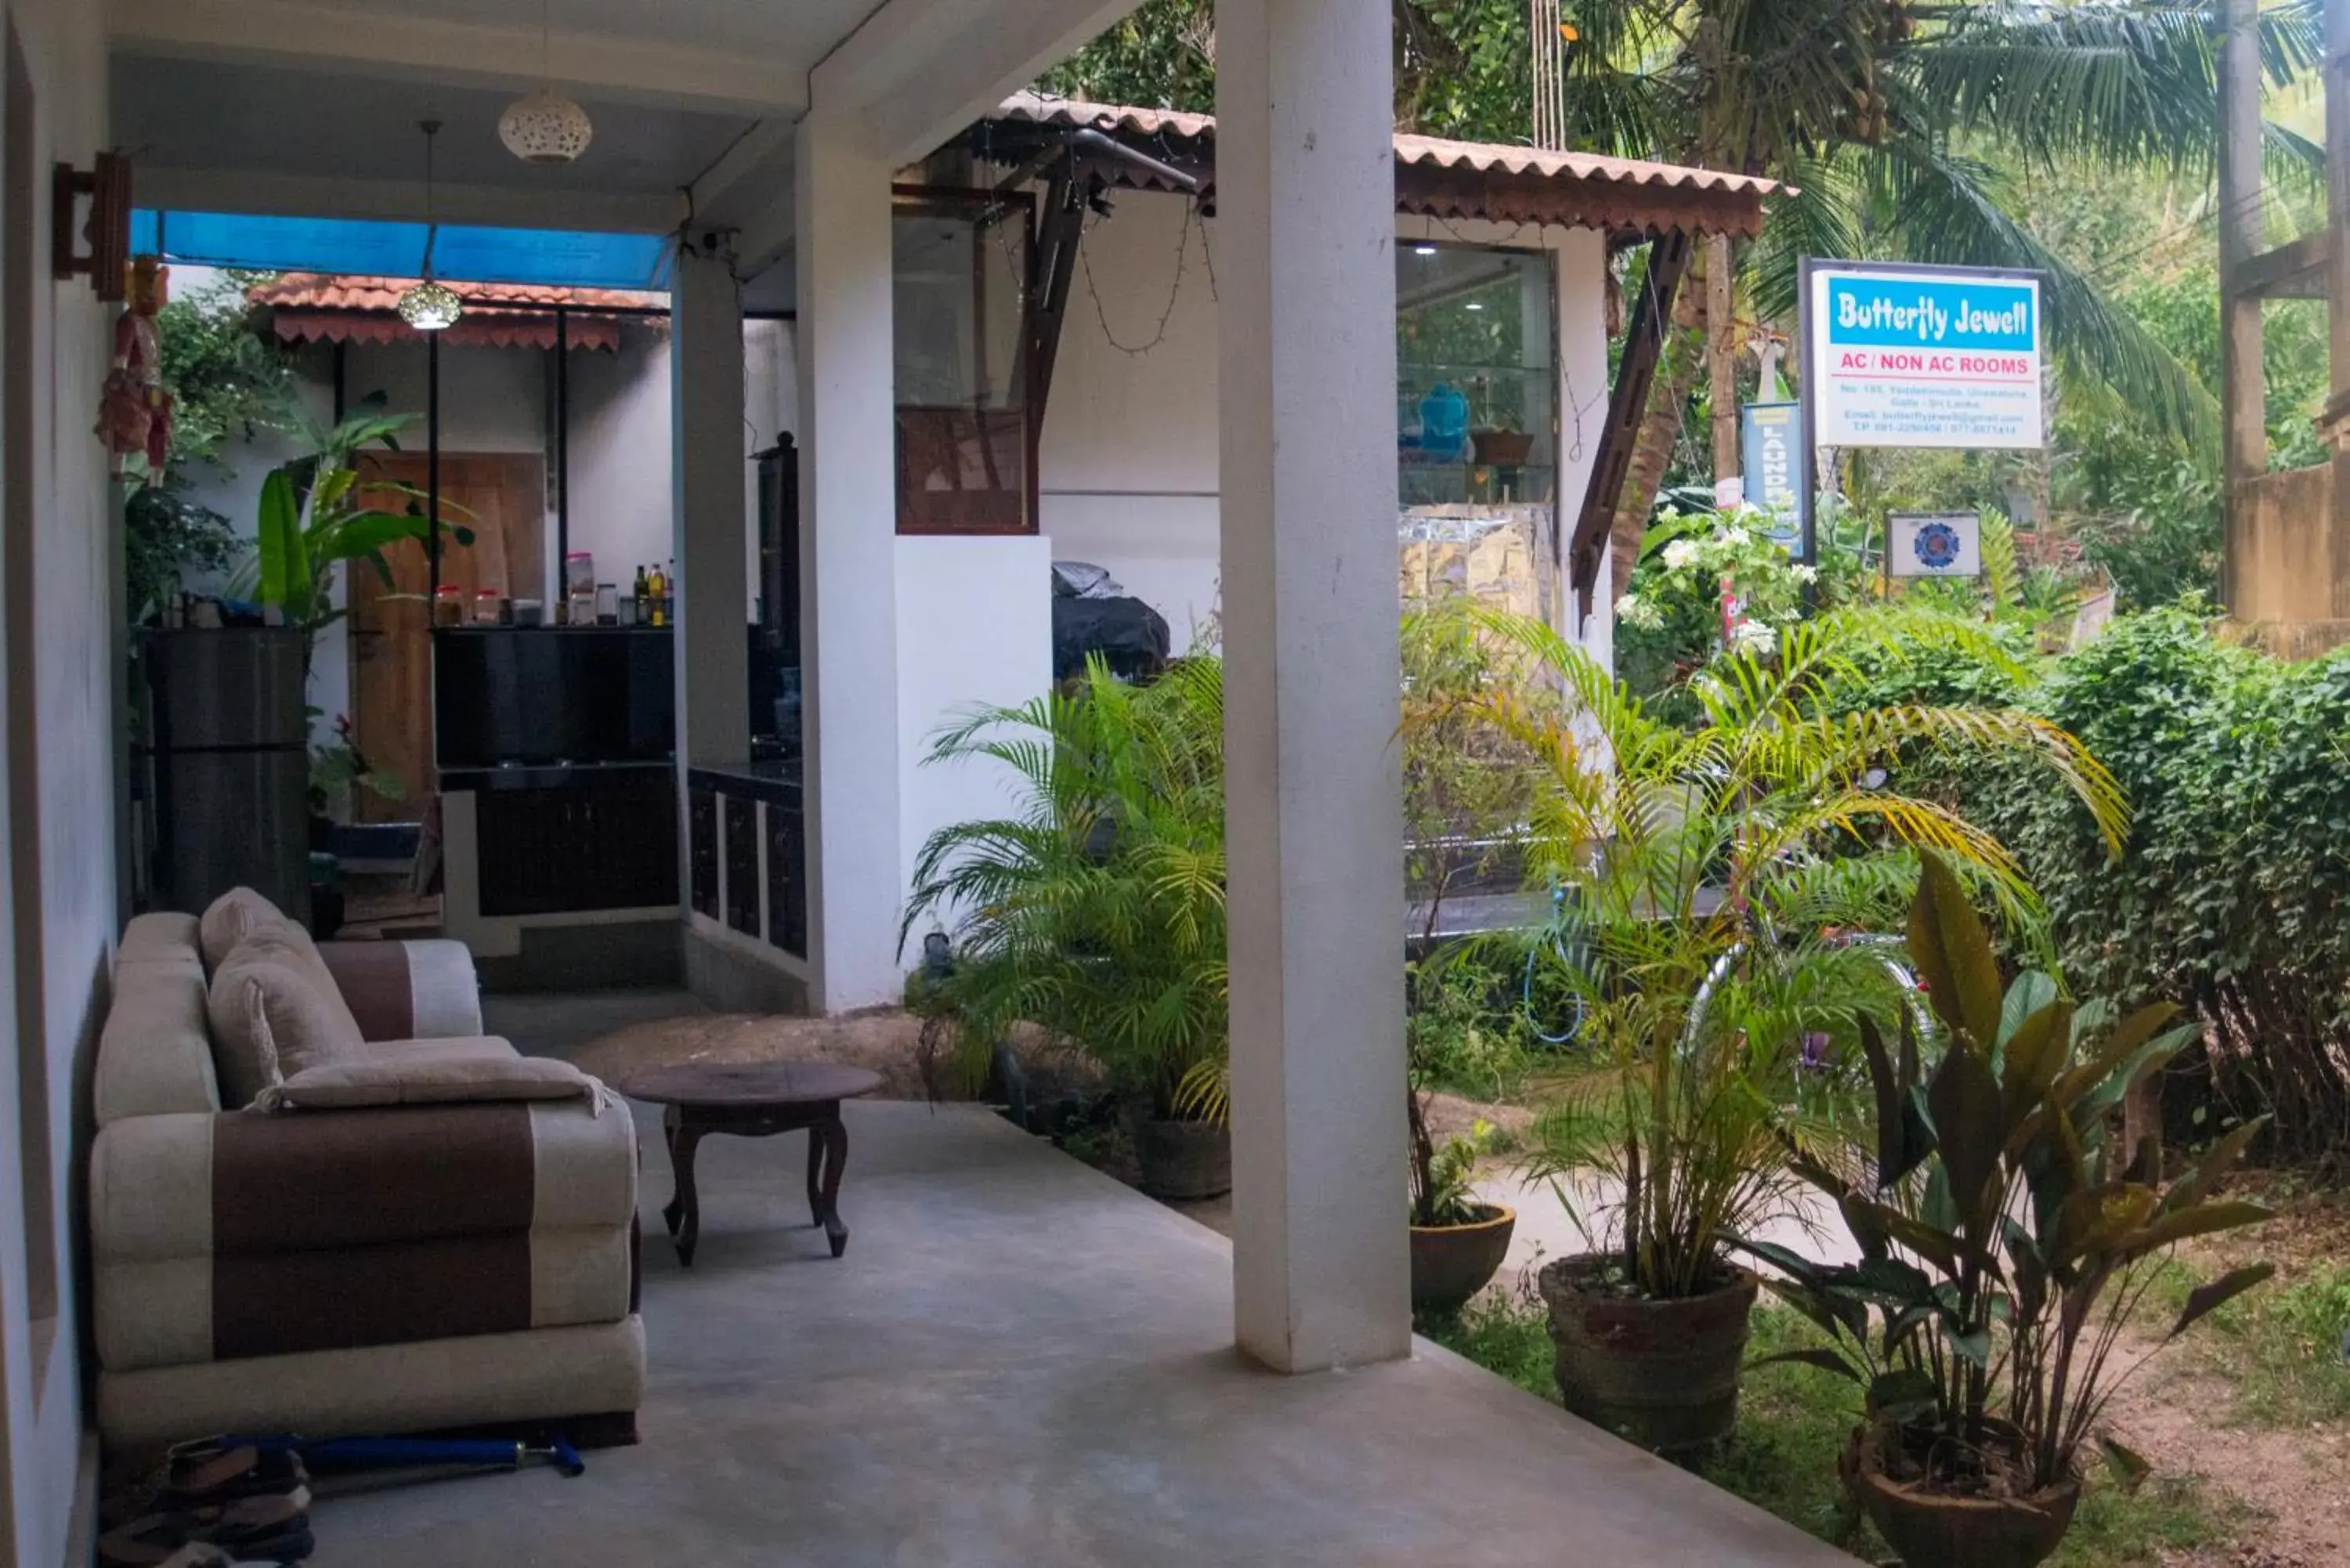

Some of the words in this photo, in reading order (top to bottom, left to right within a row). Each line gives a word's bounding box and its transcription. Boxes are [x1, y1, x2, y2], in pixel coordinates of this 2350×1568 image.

[1837, 292, 1948, 341] Butterfly
[1954, 298, 2027, 335] Jewell
[1841, 352, 1867, 370] AC
[1880, 354, 1923, 370] NON
[1929, 356, 1954, 372] AC
[1960, 357, 2029, 374] ROOMS
